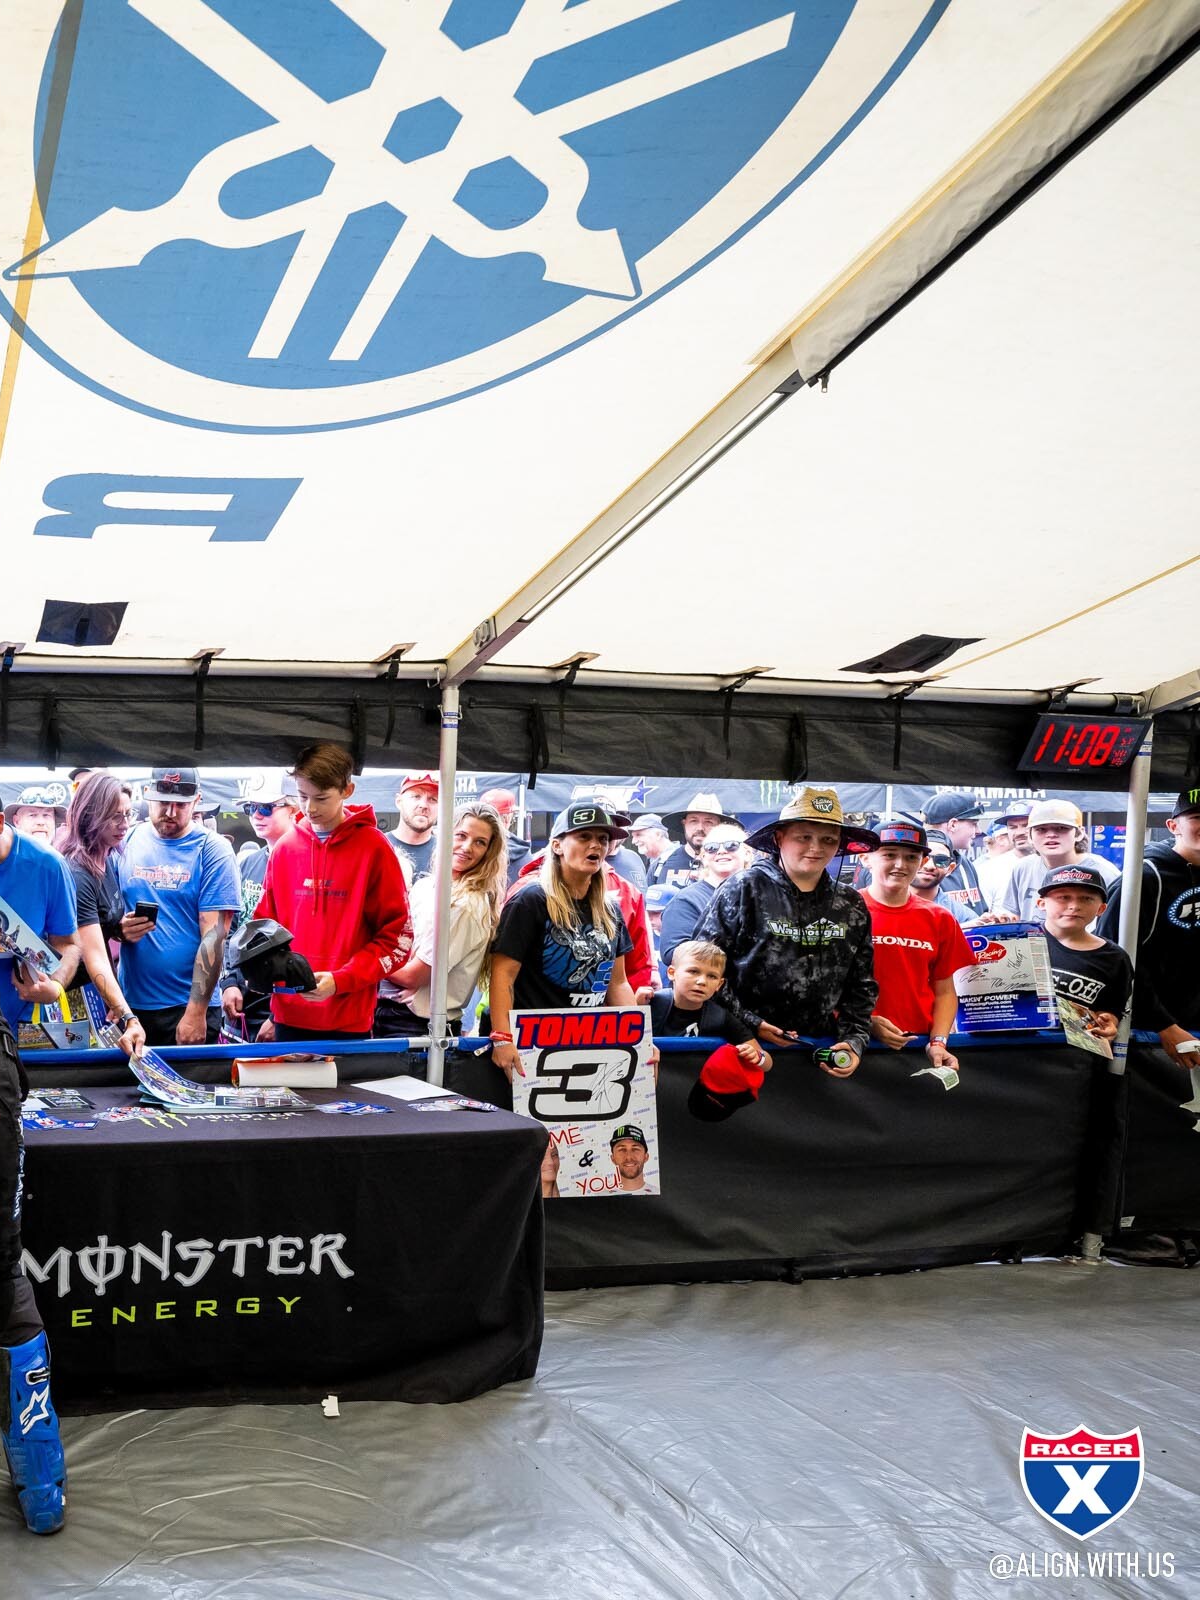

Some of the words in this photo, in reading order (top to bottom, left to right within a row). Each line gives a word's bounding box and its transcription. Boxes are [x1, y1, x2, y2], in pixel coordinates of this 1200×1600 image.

[1034, 723, 1121, 767] 11:08
[872, 936, 934, 951] HONDA
[569, 993, 606, 1007] TOMA
[516, 1011, 645, 1049] TOMAC
[529, 1047, 638, 1122] 3
[548, 1127, 584, 1148] ME
[579, 1149, 593, 1167] &
[575, 1166, 623, 1195] YOU!
[19, 1230, 354, 1297] MONSTER
[71, 1296, 301, 1328] ENERGY
